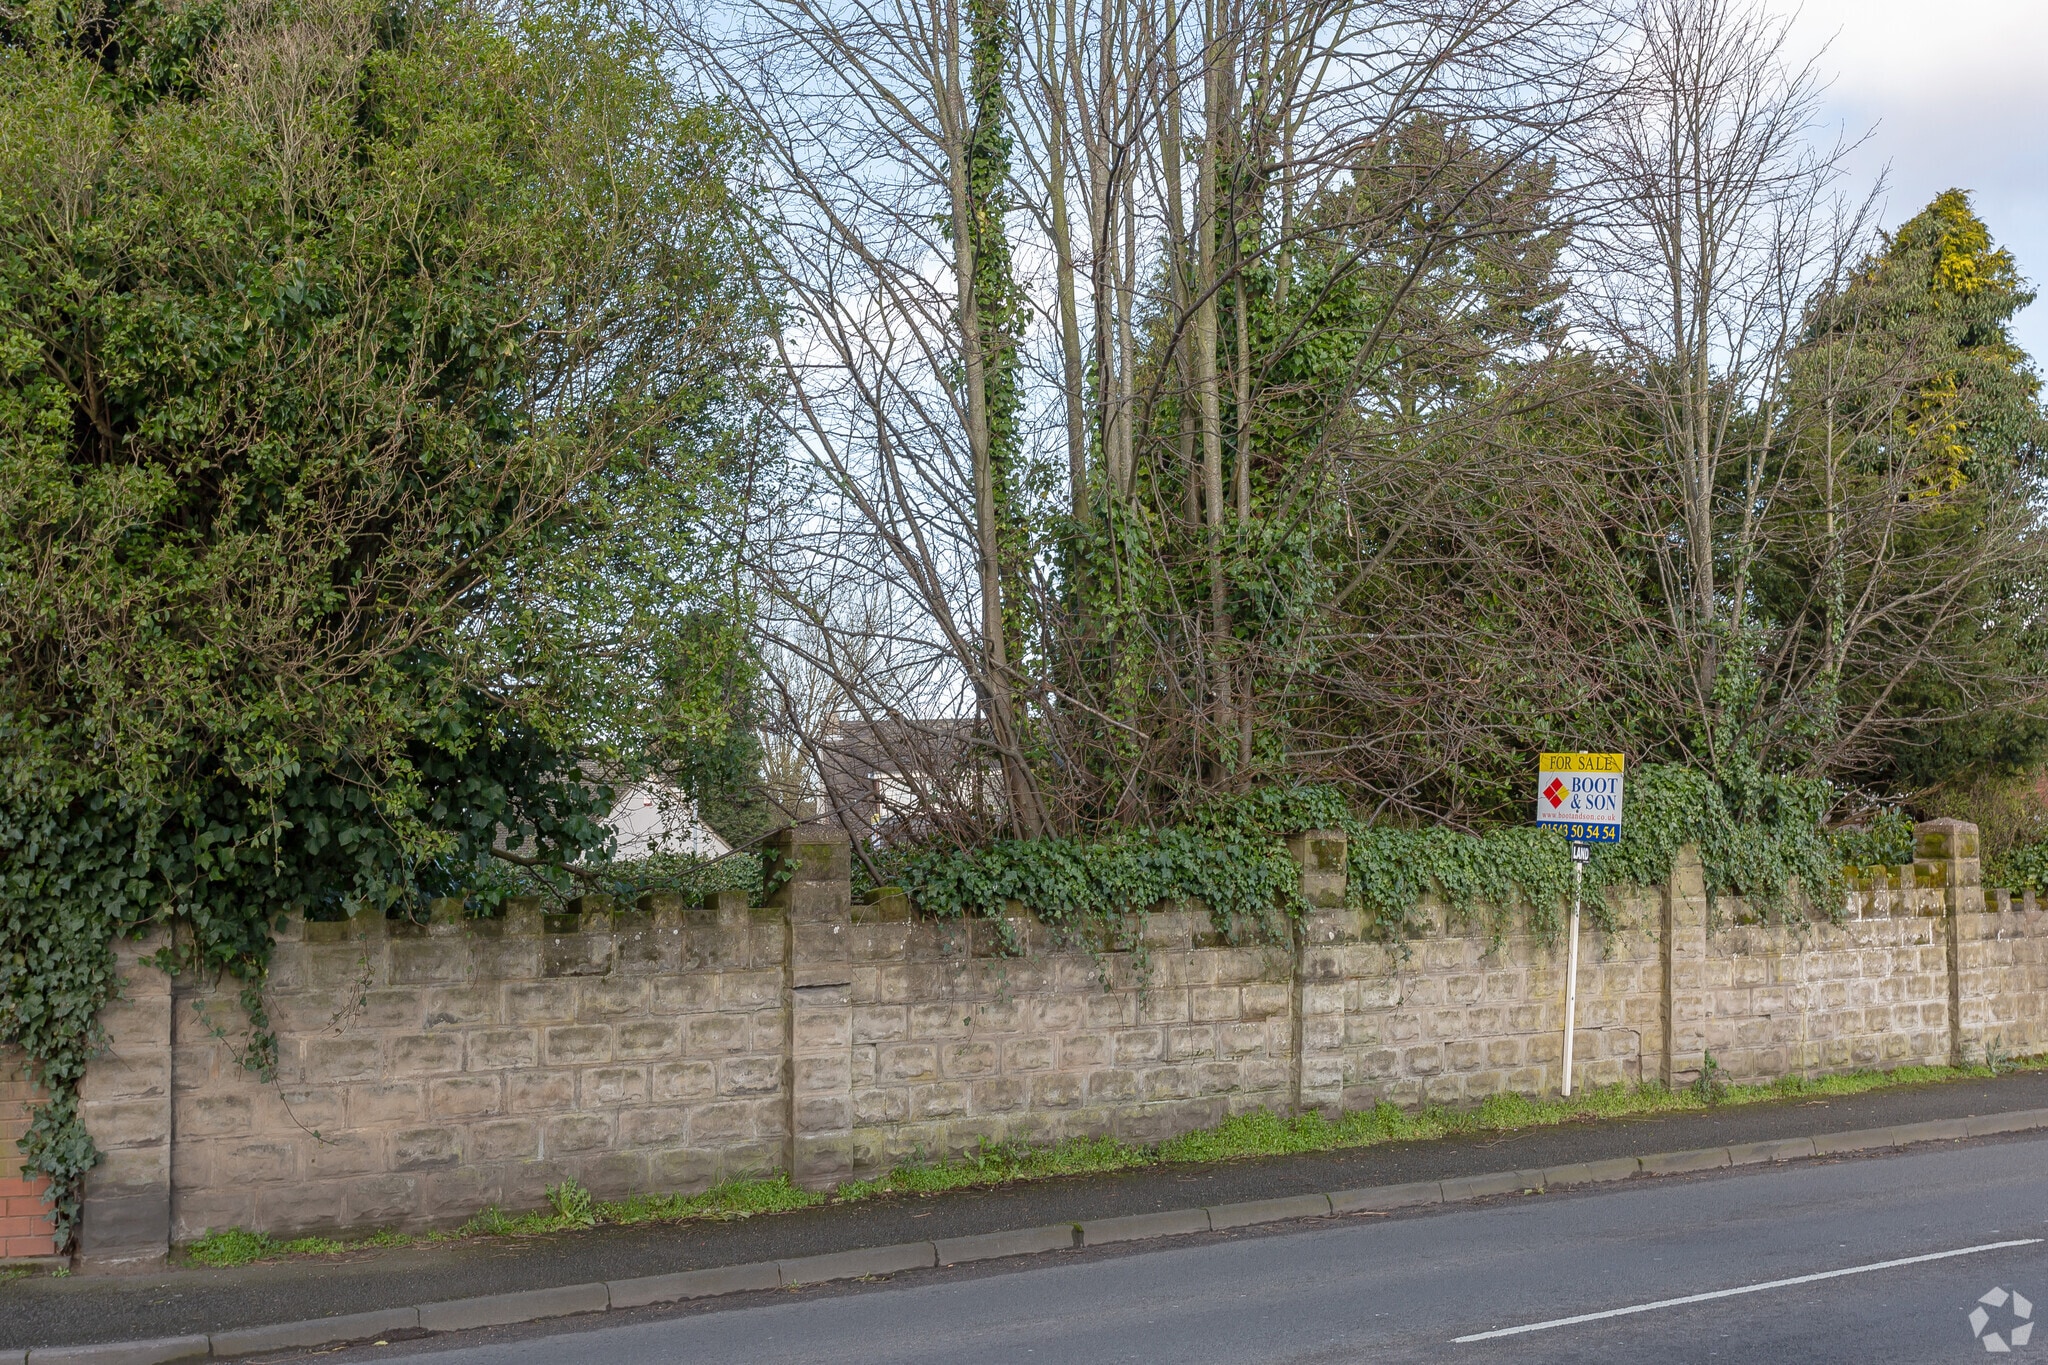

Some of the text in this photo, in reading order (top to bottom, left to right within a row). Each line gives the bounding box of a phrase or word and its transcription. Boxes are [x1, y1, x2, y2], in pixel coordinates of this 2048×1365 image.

[1549, 756, 1613, 771] FOR SALE
[1572, 777, 1618, 794] BOOT
[1570, 793, 1616, 811] & SON
[1542, 811, 1616, 822] www.bootandson.co.uk
[1570, 824, 1584, 838] 50
[1586, 825, 1600, 839] 54
[1602, 826, 1616, 840] 54
[1573, 846, 1590, 860] LAND
